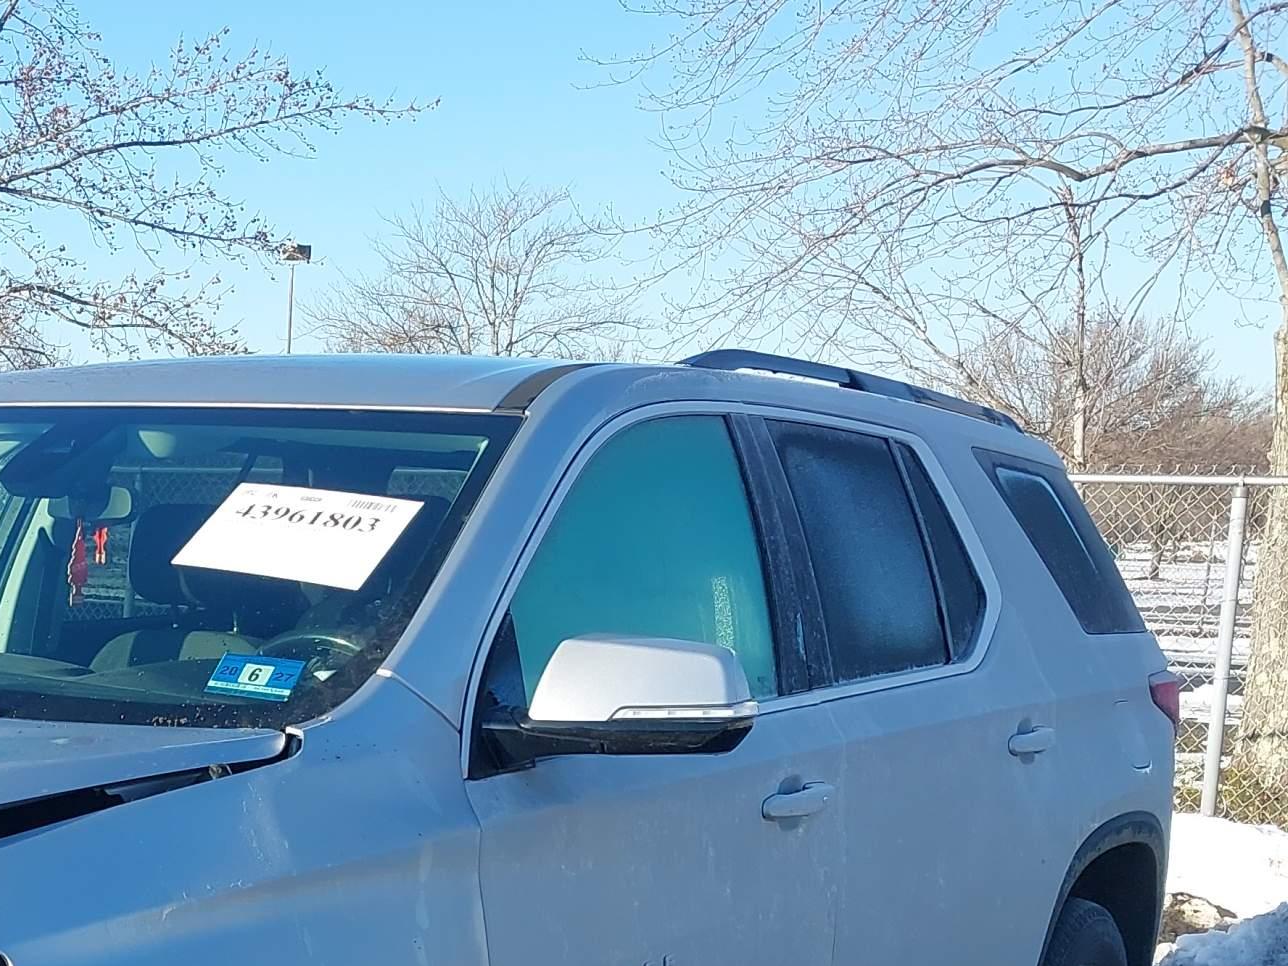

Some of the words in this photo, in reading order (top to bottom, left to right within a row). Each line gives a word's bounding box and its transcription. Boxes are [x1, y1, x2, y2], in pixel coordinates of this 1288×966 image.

[235, 503, 381, 533] 43961803
[219, 665, 239, 677] 20
[247, 667, 263, 682] 6
[272, 672, 295, 682] 27
